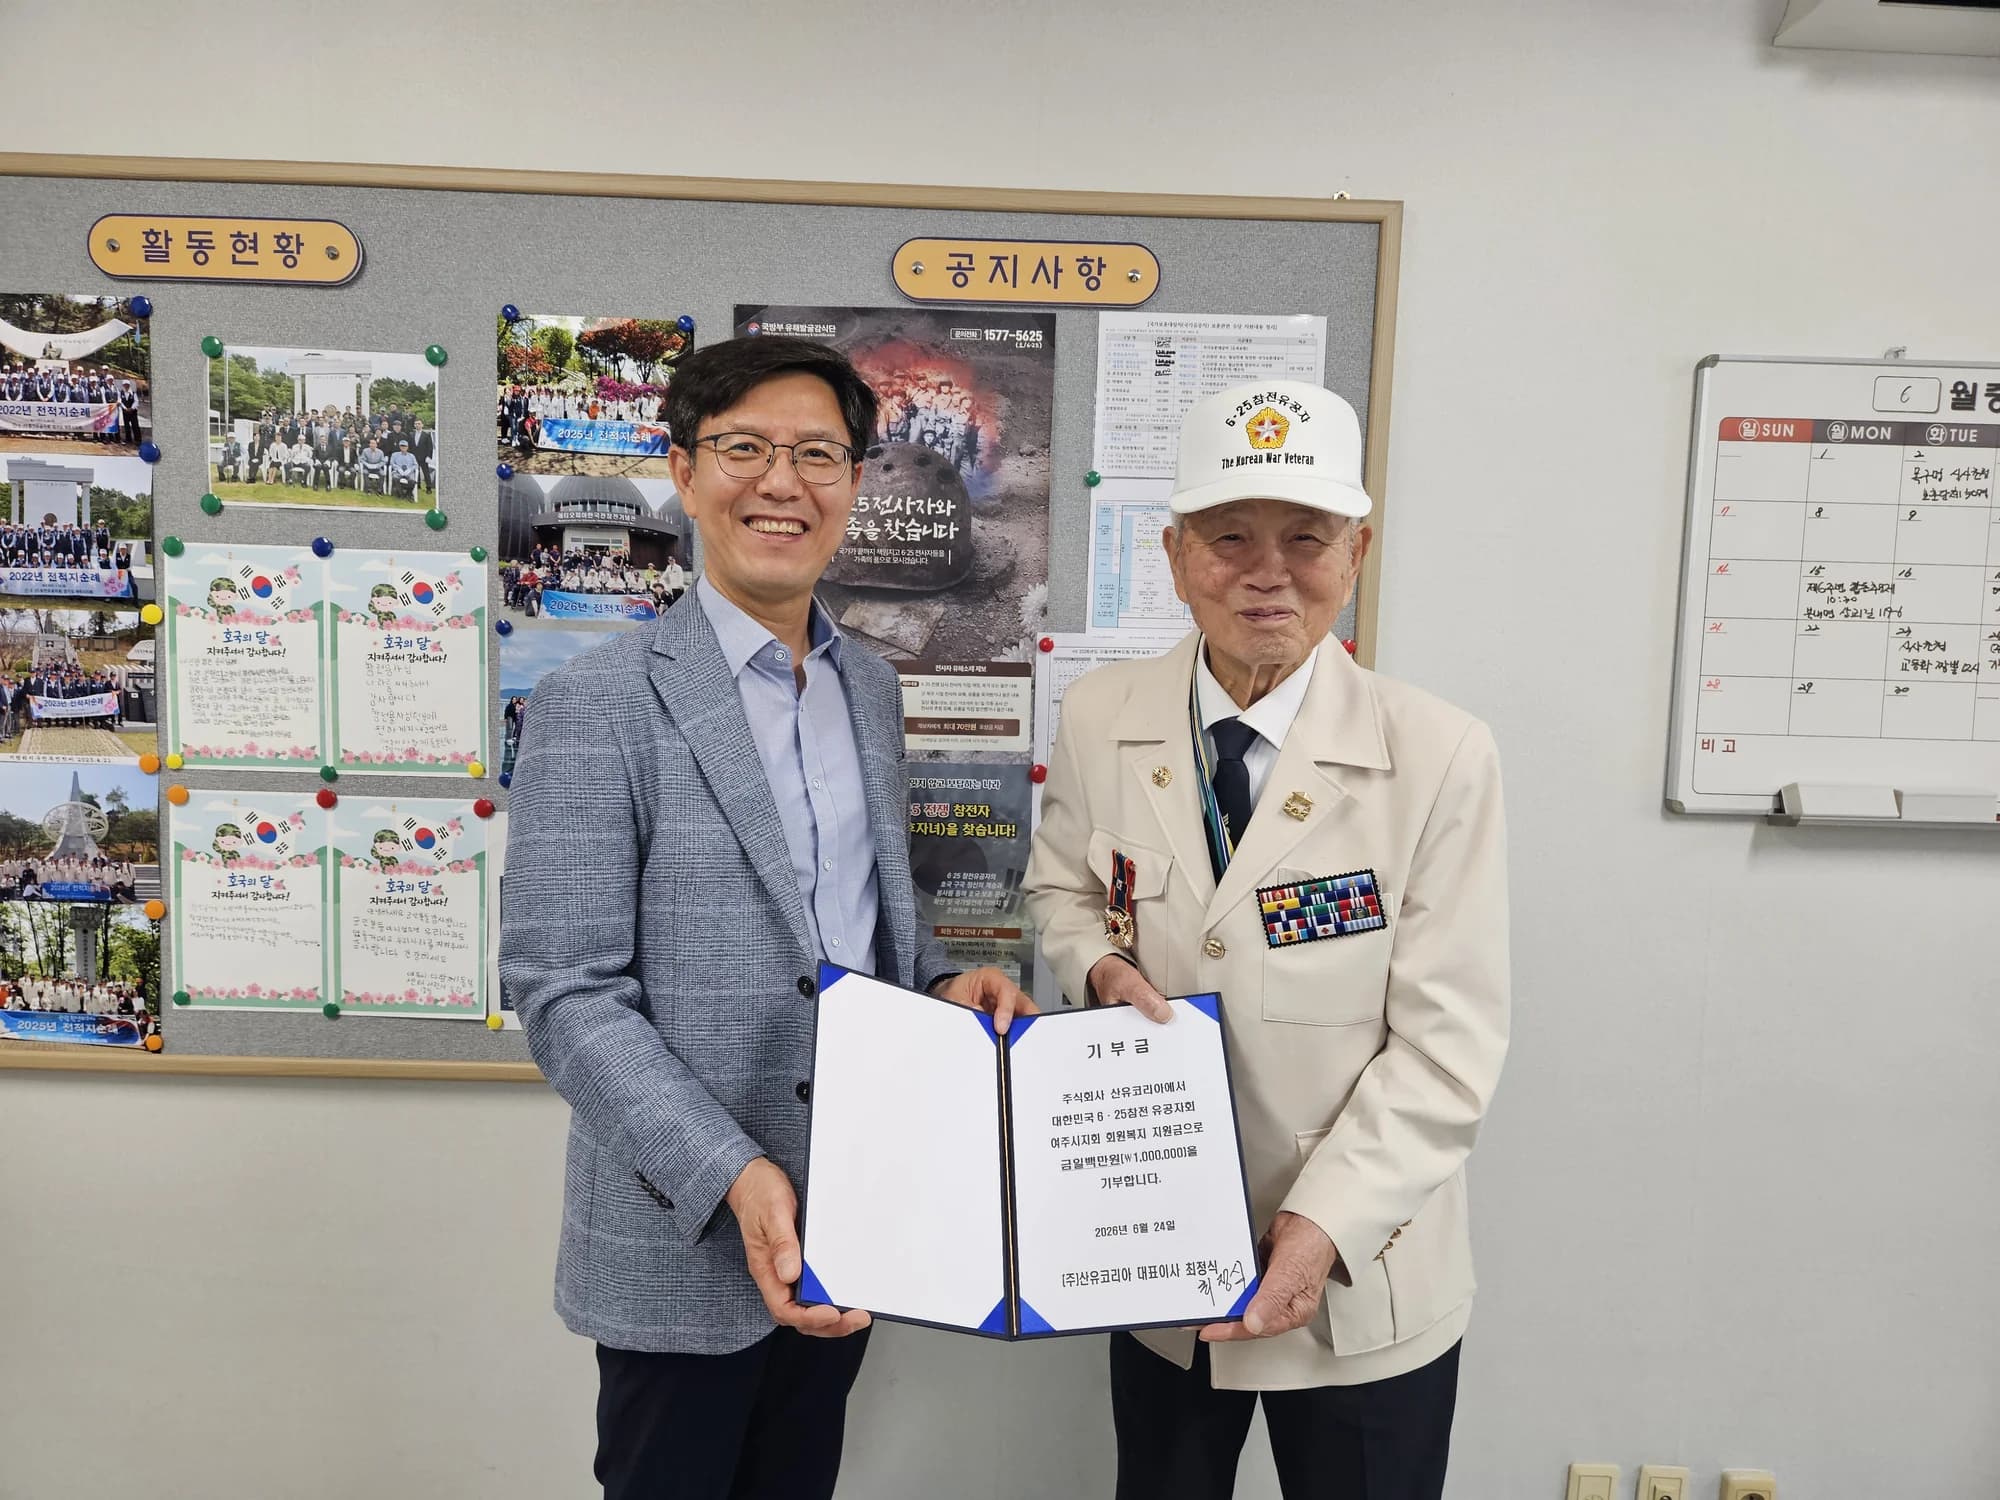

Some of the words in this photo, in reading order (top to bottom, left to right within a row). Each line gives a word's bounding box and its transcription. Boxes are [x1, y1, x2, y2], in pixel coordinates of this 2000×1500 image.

[142, 228, 304, 269] 활동현황
[946, 252, 1106, 291] 공지사항
[761, 322, 784, 332] 국방부
[785, 323, 836, 333] 유해발굴감식단
[984, 329, 1043, 341] 1577-5625
[36, 406, 91, 417] 전적지순례
[558, 428, 593, 440] 2025년
[1762, 422, 1794, 437] SUN
[1851, 425, 1892, 440] MON
[1950, 428, 1978, 442] TUE
[1222, 458, 1234, 469] The
[1236, 454, 1263, 466] Korean
[1266, 452, 1282, 463] War
[1284, 452, 1314, 465] Veteran
[1913, 450, 1925, 458] 2
[1814, 506, 1823, 518] 8
[1908, 509, 1917, 520] 9
[884, 518, 959, 541] 찾습니다
[9, 571, 42, 582] 2022년
[47, 572, 100, 583] 전적지순례
[550, 600, 589, 613] 2026년
[592, 602, 646, 615] 전적지순례
[222, 628, 252, 644] 호국의
[255, 630, 270, 645] 달
[384, 634, 413, 650] 호국의
[416, 636, 431, 651] 달
[246, 647, 286, 658] 감사합니다!
[407, 653, 447, 664] 감사합니다!
[927, 778, 946, 789] 않고
[946, 778, 982, 790] 보답하는
[982, 779, 1002, 790] 나라
[923, 803, 950, 818] 전쟁
[953, 803, 991, 818] 참전자
[962, 823, 1016, 838] 찾습니다!
[226, 872, 256, 887] 호국의
[260, 874, 274, 889] 달
[385, 878, 414, 893] 호국의
[418, 880, 432, 894] 달
[250, 891, 290, 901] 감사합니다!
[408, 897, 449, 908] 감사합니다!
[17, 1020, 57, 1032] 2025년
[63, 1022, 118, 1034] 전적지순례
[1063, 1089, 1105, 1104] 주식회사
[1110, 1080, 1186, 1099] 산유코리아에서
[1052, 1112, 1094, 1127] 대한민국
[1152, 1101, 1195, 1116] 유공자회
[1051, 1132, 1101, 1149] 여주시지회
[1106, 1127, 1147, 1143] 회원복지
[1152, 1121, 1204, 1138] 지원금으로
[1101, 1173, 1161, 1189] 기부합니다.
[1095, 1224, 1128, 1237] 2026년
[1133, 1222, 1148, 1234] 6월
[1154, 1220, 1176, 1232] 24일
[1137, 1263, 1180, 1281] 대표이사
[1186, 1260, 1218, 1276] 최정식
